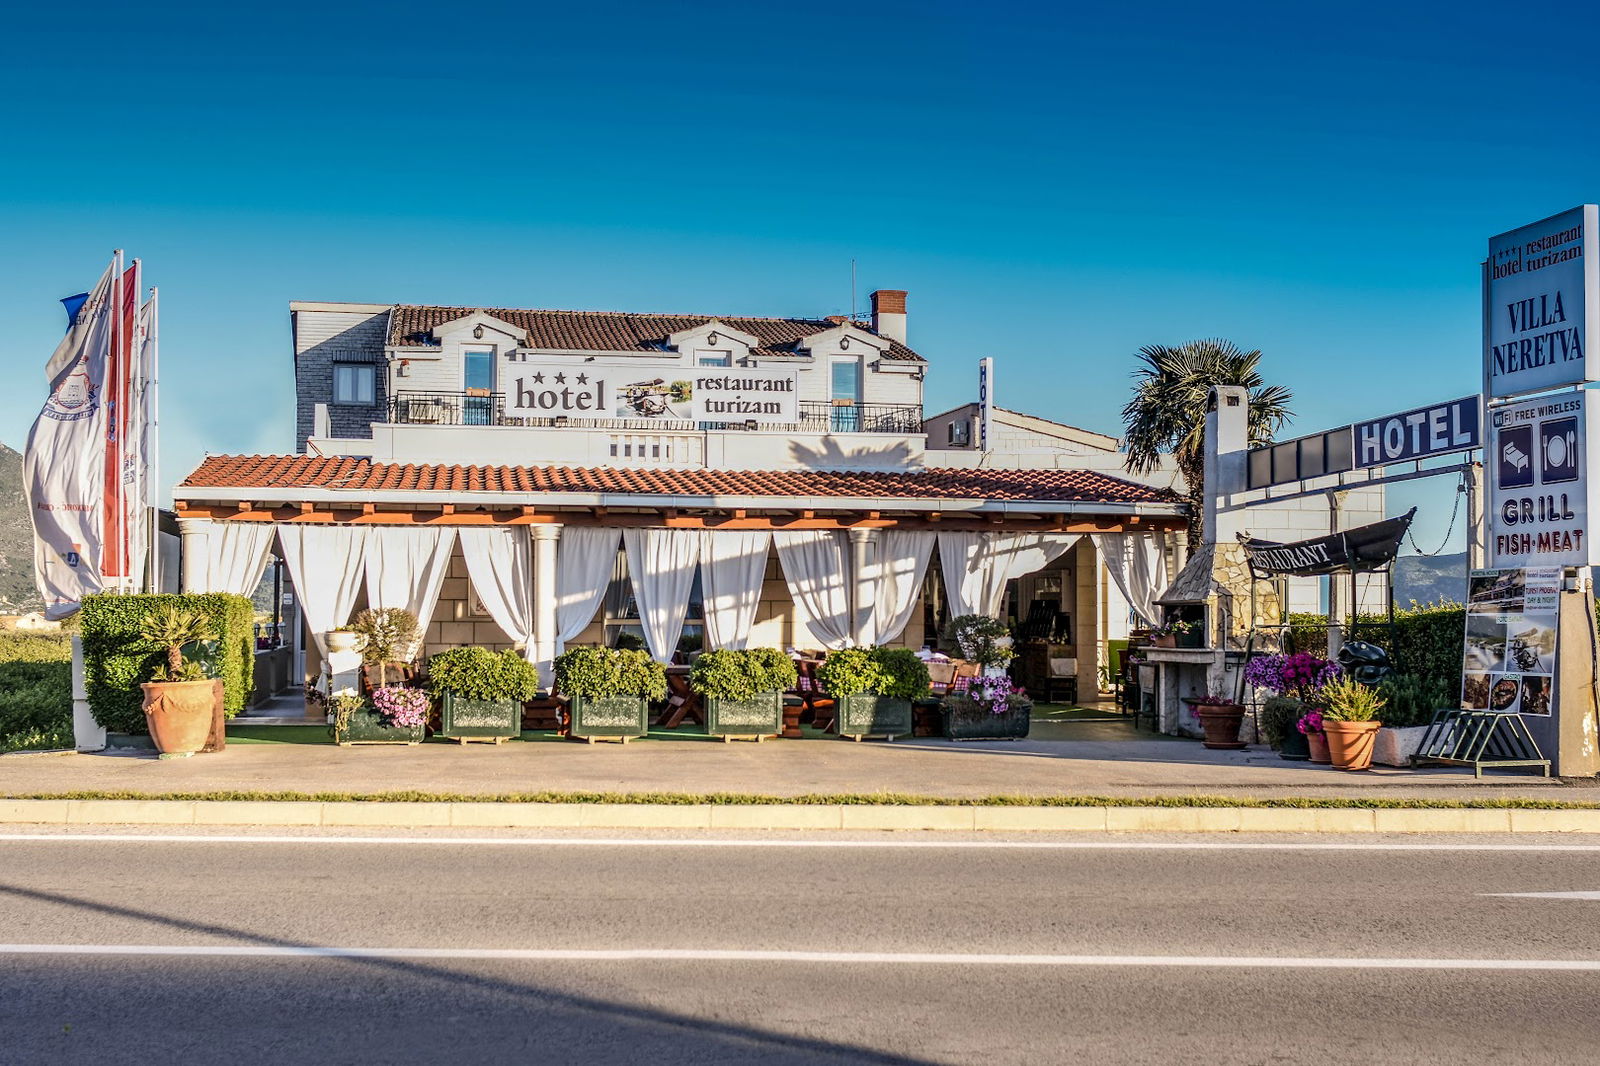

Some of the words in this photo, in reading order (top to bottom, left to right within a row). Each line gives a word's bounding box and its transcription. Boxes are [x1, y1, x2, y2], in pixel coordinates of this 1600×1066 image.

[1526, 223, 1582, 256] restaurant
[1492, 246, 1522, 280] hotel
[1526, 245, 1583, 273] turizam
[1507, 290, 1567, 334] VILLA
[1492, 326, 1584, 377] NERETVA
[514, 377, 606, 411] hotel
[696, 375, 795, 393] restaurant
[705, 395, 782, 414] turizam
[1515, 409, 1536, 421] FREE
[1537, 400, 1581, 417] WIRELESS
[1361, 404, 1471, 464] HOTEL
[1501, 493, 1575, 526] GRILL
[1249, 543, 1331, 570] RESTAURANT
